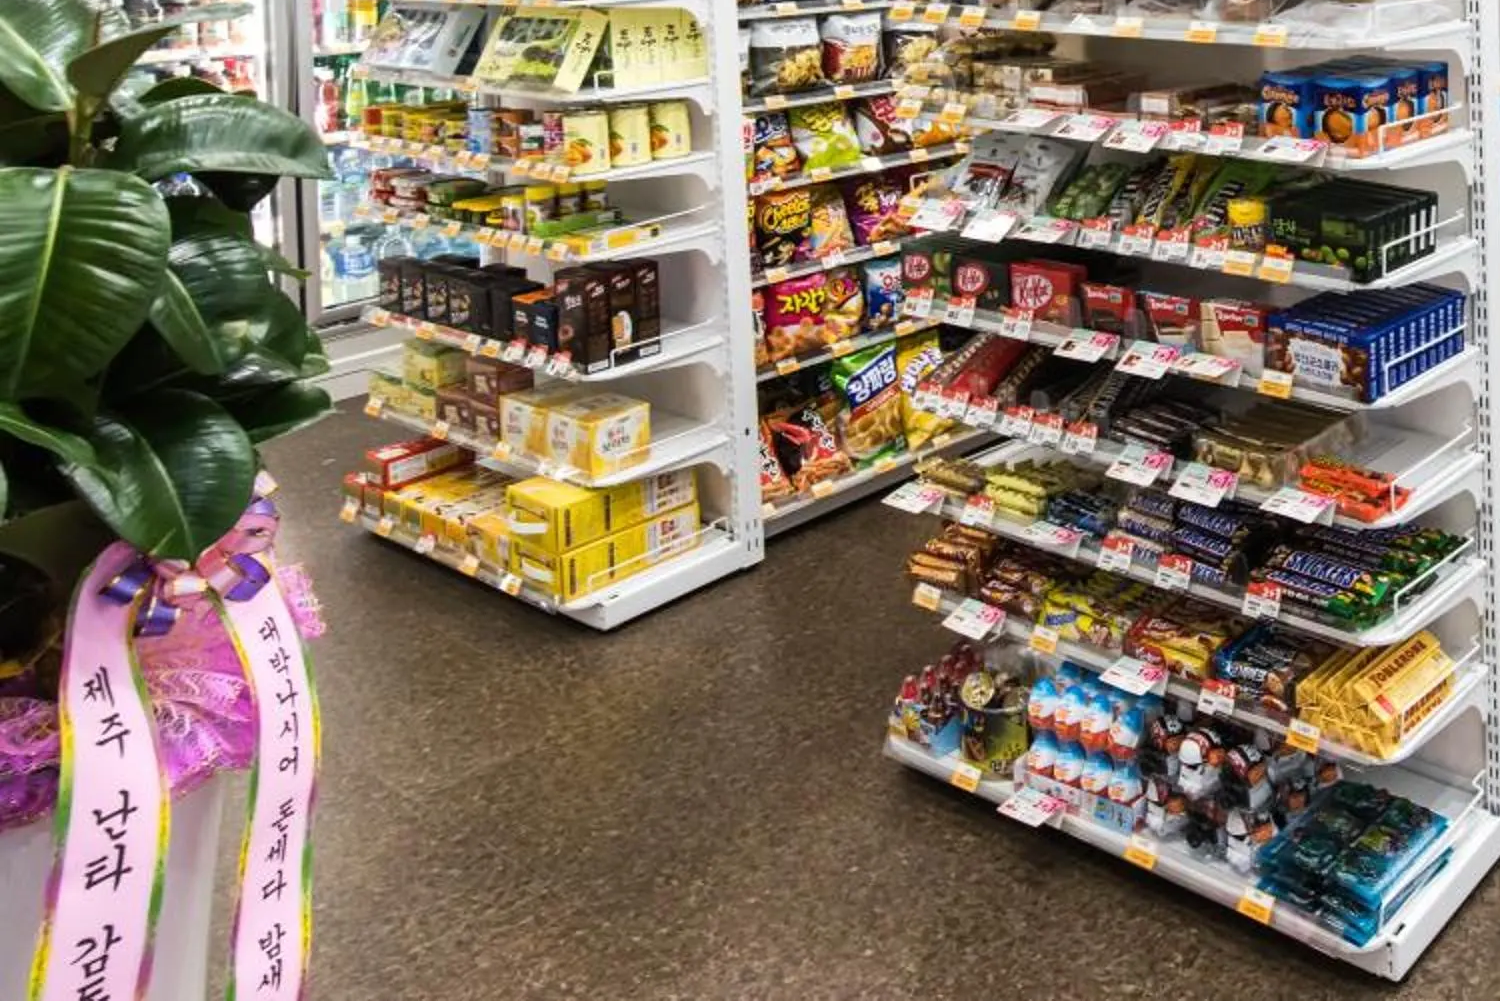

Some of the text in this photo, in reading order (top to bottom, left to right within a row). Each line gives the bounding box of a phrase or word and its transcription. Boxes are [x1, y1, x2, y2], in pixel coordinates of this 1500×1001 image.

[848, 357, 896, 402] 양파링
[1284, 550, 1362, 588] SNICKERS
[1368, 639, 1427, 688] TOBLERONE
[82, 666, 131, 758] 제주
[256, 615, 300, 992] 대박나시어 돈세다 밤새
[84, 789, 139, 892] 난타
